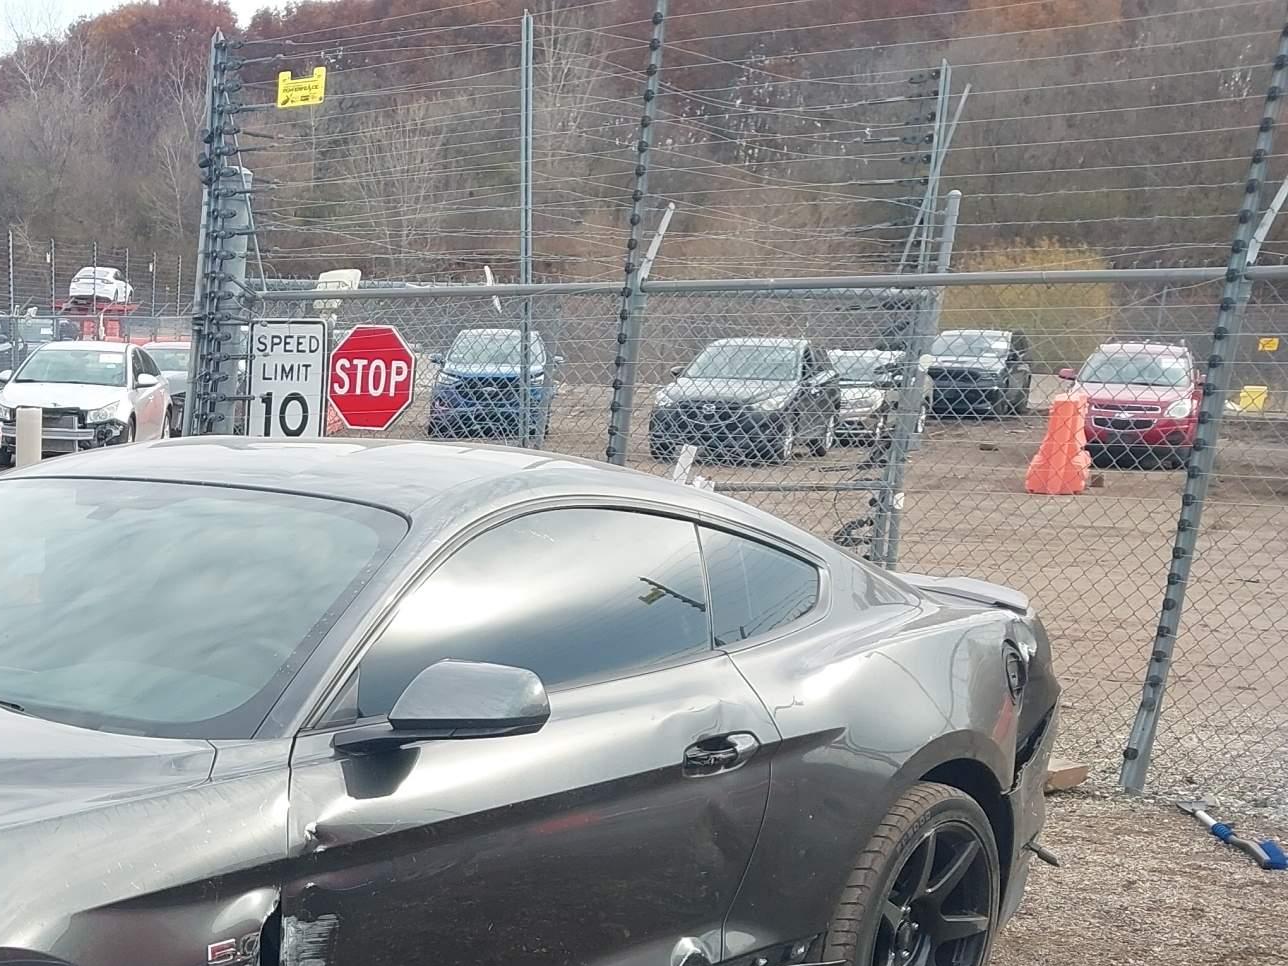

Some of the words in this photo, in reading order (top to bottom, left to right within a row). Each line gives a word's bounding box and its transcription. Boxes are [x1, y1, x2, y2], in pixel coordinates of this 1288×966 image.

[256, 334, 320, 354] SPEED
[262, 363, 312, 382] LIMIT
[333, 358, 409, 397] STOP
[261, 392, 309, 437] 10
